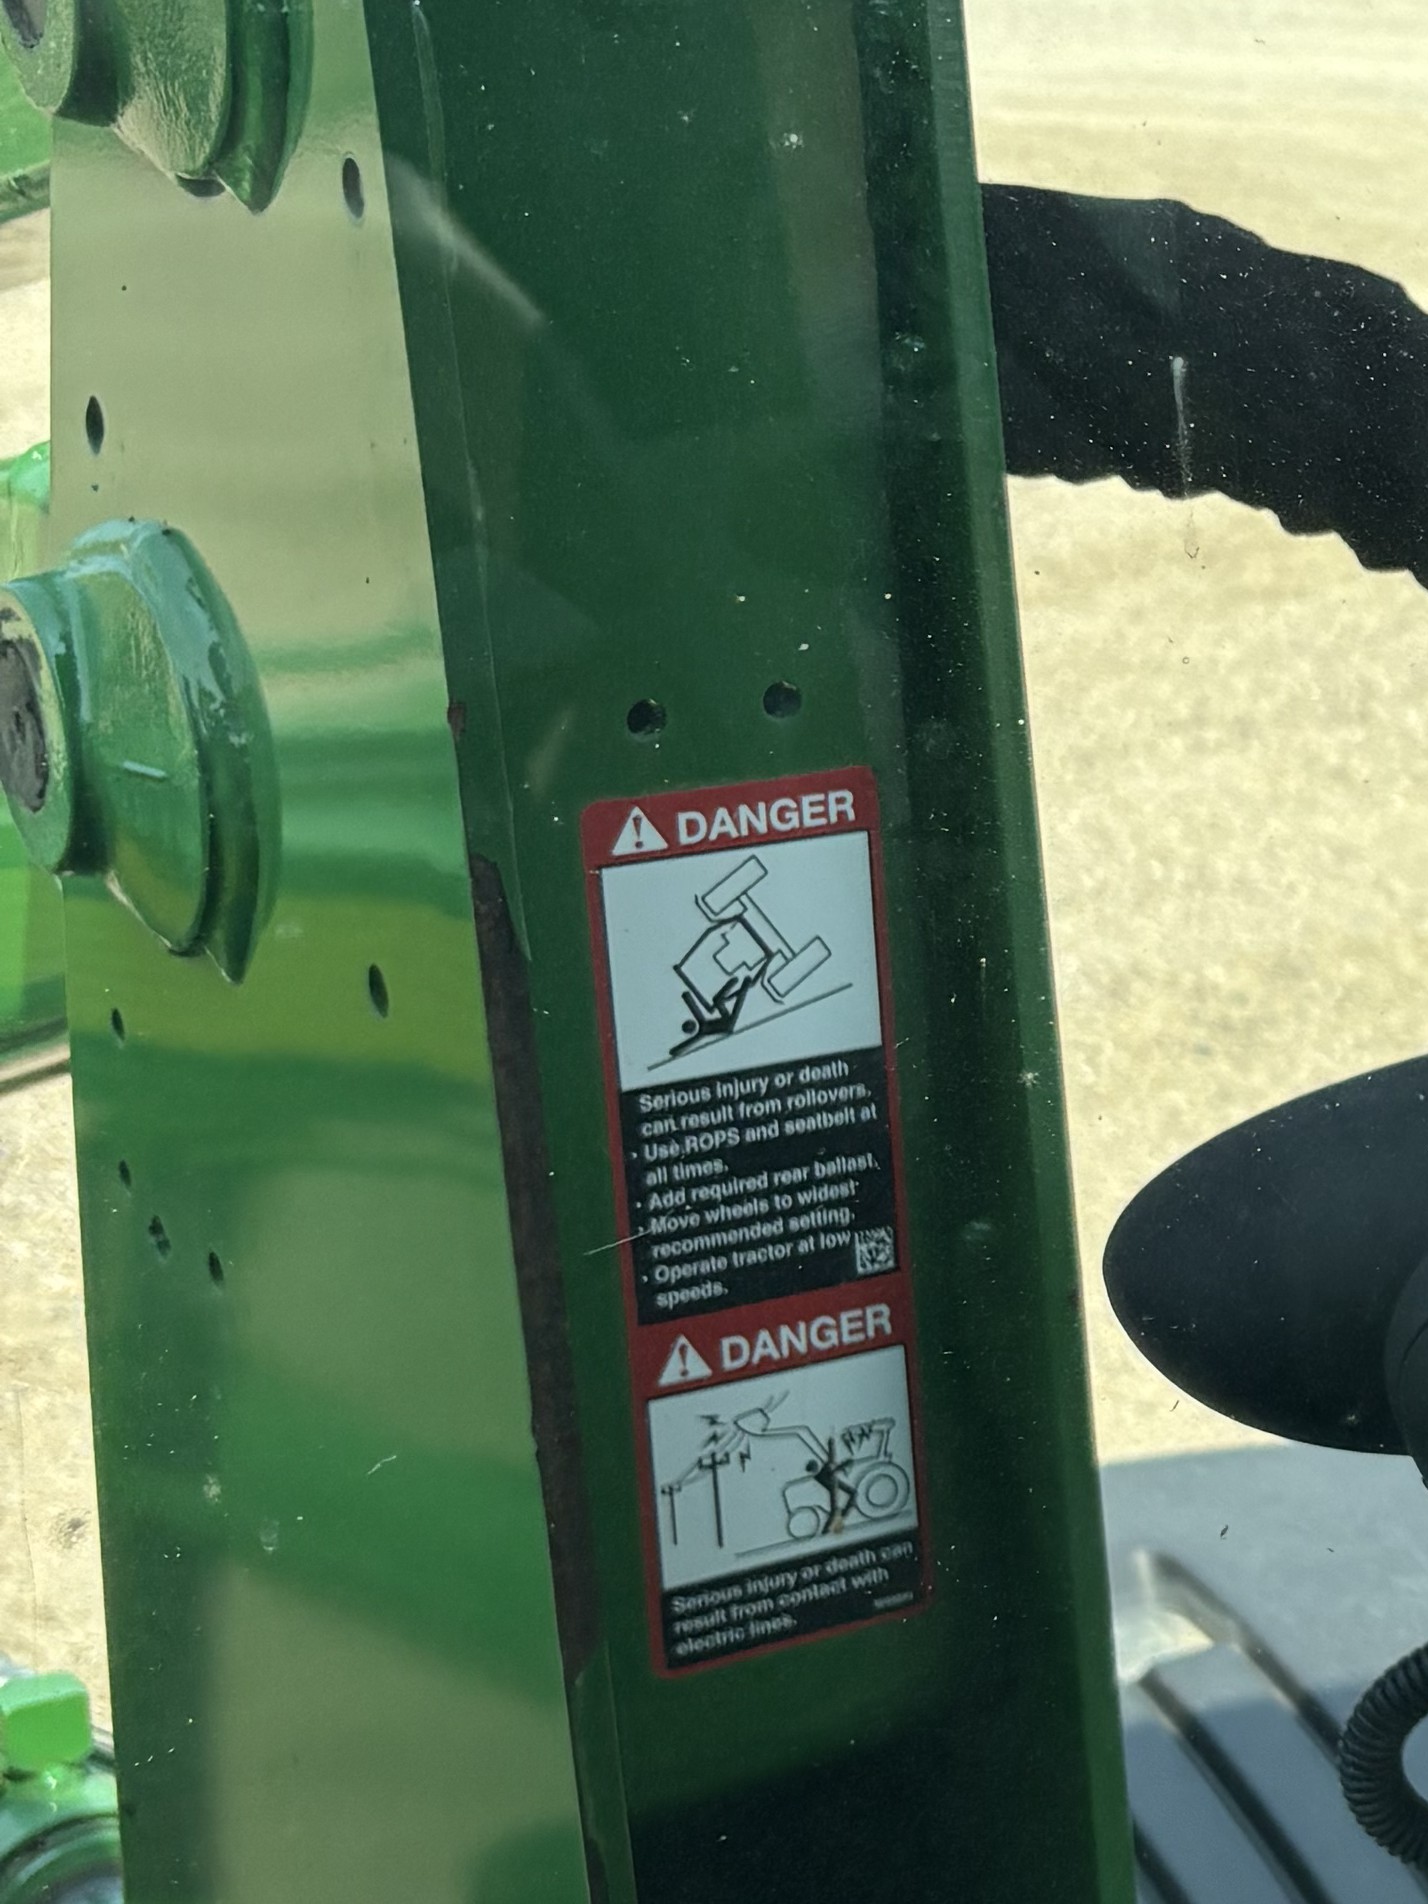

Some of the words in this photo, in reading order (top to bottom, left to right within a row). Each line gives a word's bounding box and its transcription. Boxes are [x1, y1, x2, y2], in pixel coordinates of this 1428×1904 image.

[676, 789, 856, 846] DANGER
[638, 1085, 712, 1114] Serious
[716, 1070, 770, 1100] injury
[774, 1070, 794, 1088] or
[798, 1059, 850, 1084] death
[641, 1116, 675, 1138] can
[680, 1103, 735, 1131] result
[738, 1099, 782, 1120] from
[786, 1083, 872, 1111] rollovers.
[643, 1140, 680, 1162] Use
[684, 1127, 741, 1153] ROPS
[745, 1119, 780, 1143] and
[784, 1107, 856, 1135] seatbelt
[860, 1102, 877, 1122] at
[645, 1165, 668, 1187] all
[673, 1158, 729, 1181] times.
[648, 1187, 686, 1211] Add
[691, 1171, 769, 1203] required
[773, 1165, 809, 1185] rear
[813, 1152, 879, 1178] ballast.
[650, 1210, 701, 1236] Move
[704, 1197, 770, 1223] wheels
[774, 1192, 793, 1210] to
[797, 1178, 856, 1205] widest
[652, 1217, 784, 1259] recommended
[788, 1206, 856, 1234] setting.
[654, 1255, 728, 1285] Operate
[731, 1240, 794, 1268] tractor
[798, 1234, 815, 1254] at
[819, 1229, 852, 1249] low
[655, 1280, 729, 1311] speeds.
[720, 1302, 893, 1372] DANGER
[671, 1583, 743, 1614] Serious
[746, 1569, 798, 1596] injury
[801, 1562, 822, 1580] or
[824, 1548, 876, 1575] death
[880, 1540, 914, 1562] can
[673, 1608, 728, 1635] result
[730, 1596, 775, 1620] from
[778, 1577, 848, 1606] contact
[851, 1565, 889, 1590] with
[674, 1625, 745, 1657] electric
